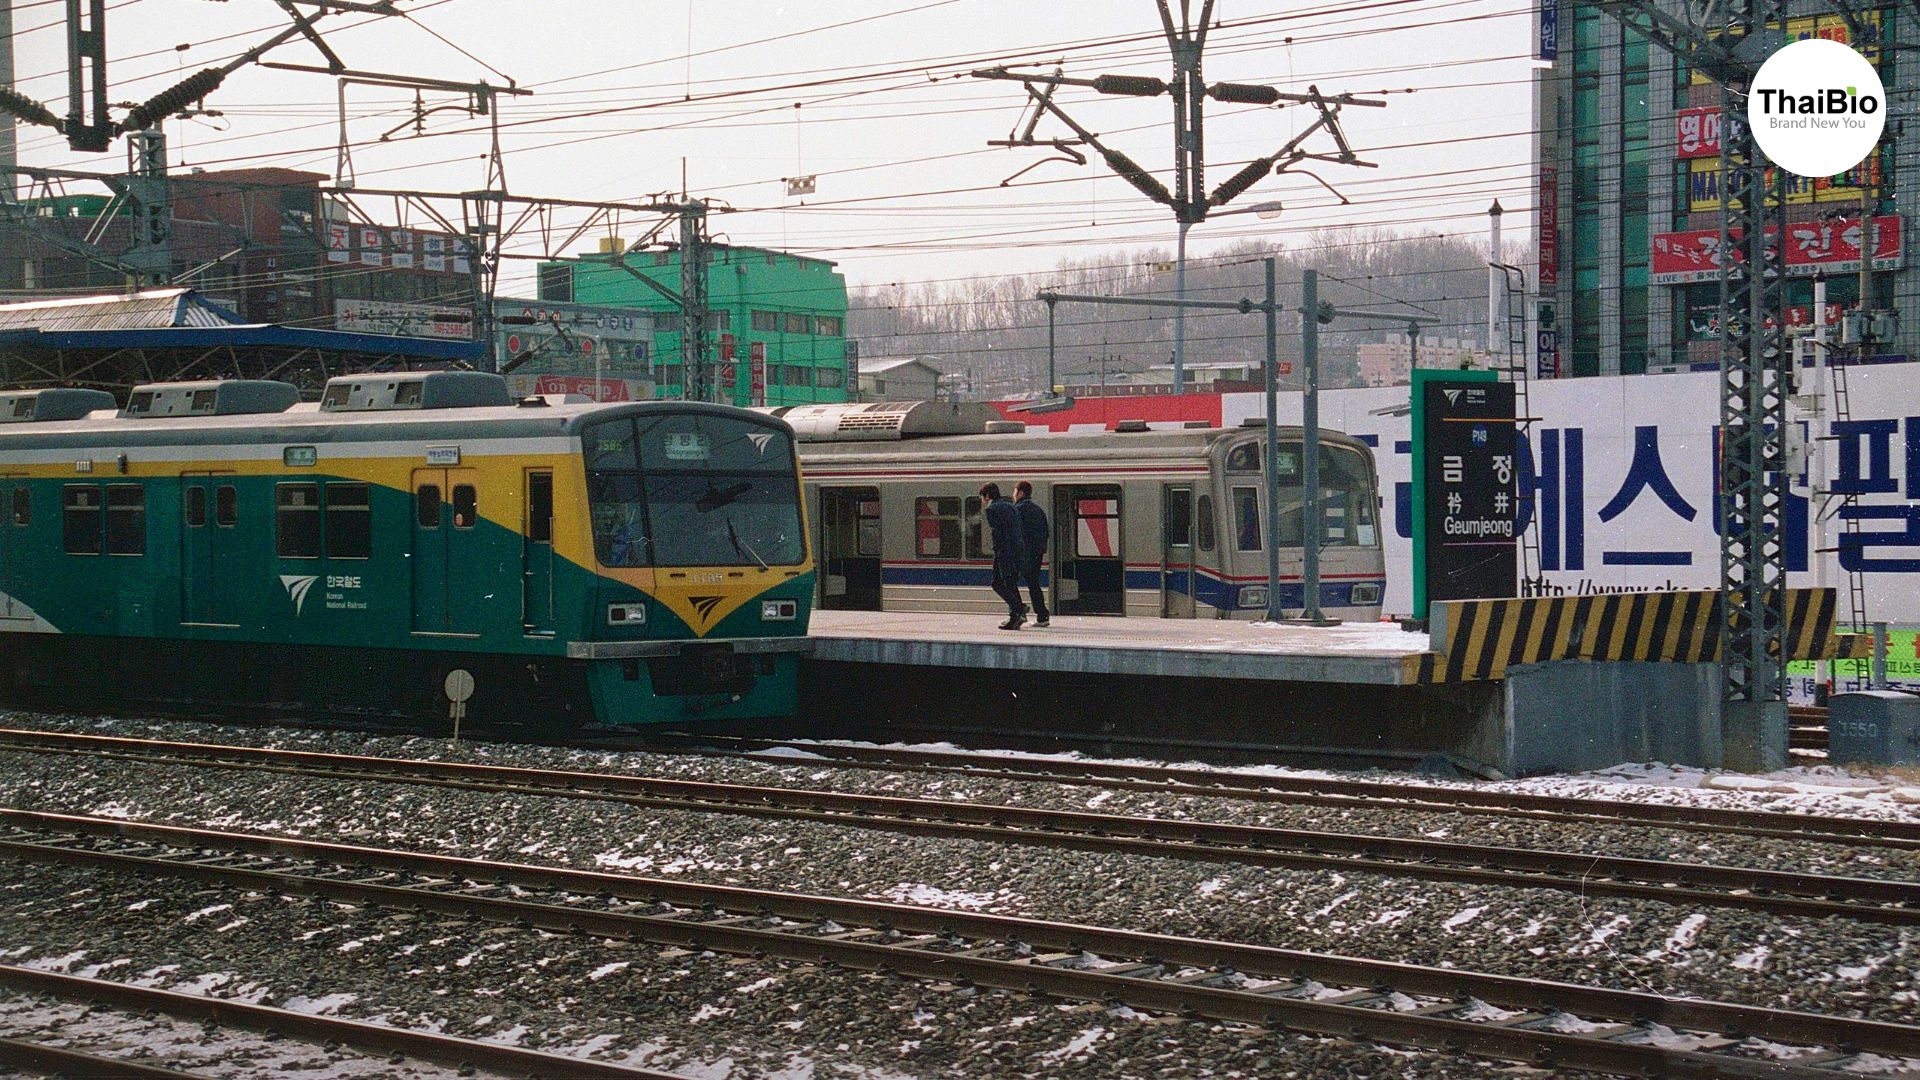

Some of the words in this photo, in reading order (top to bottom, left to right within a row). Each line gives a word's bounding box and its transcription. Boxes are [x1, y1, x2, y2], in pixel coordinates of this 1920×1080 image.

[1657, 274, 1678, 283] LIVE
[1444, 516, 1513, 537] Geumjeong
[326, 574, 361, 588] 한국철도
[326, 592, 344, 600] Korean
